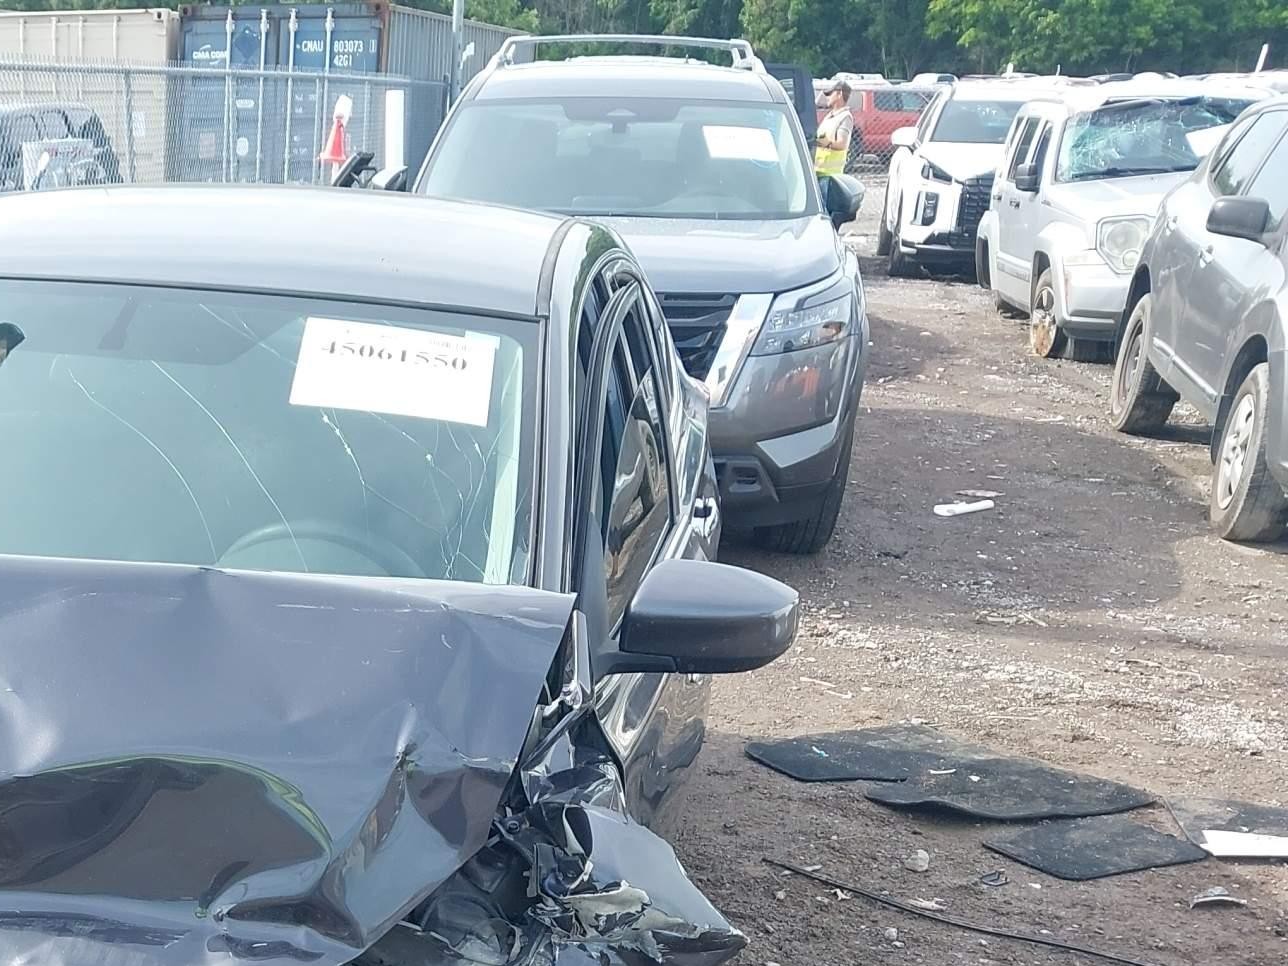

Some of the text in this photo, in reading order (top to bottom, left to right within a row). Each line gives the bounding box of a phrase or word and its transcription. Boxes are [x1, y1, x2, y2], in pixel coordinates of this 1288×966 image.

[334, 39, 363, 53] 803073
[193, 51, 210, 59] CMA
[333, 53, 353, 66] 42G1
[321, 341, 468, 370] 45061550
